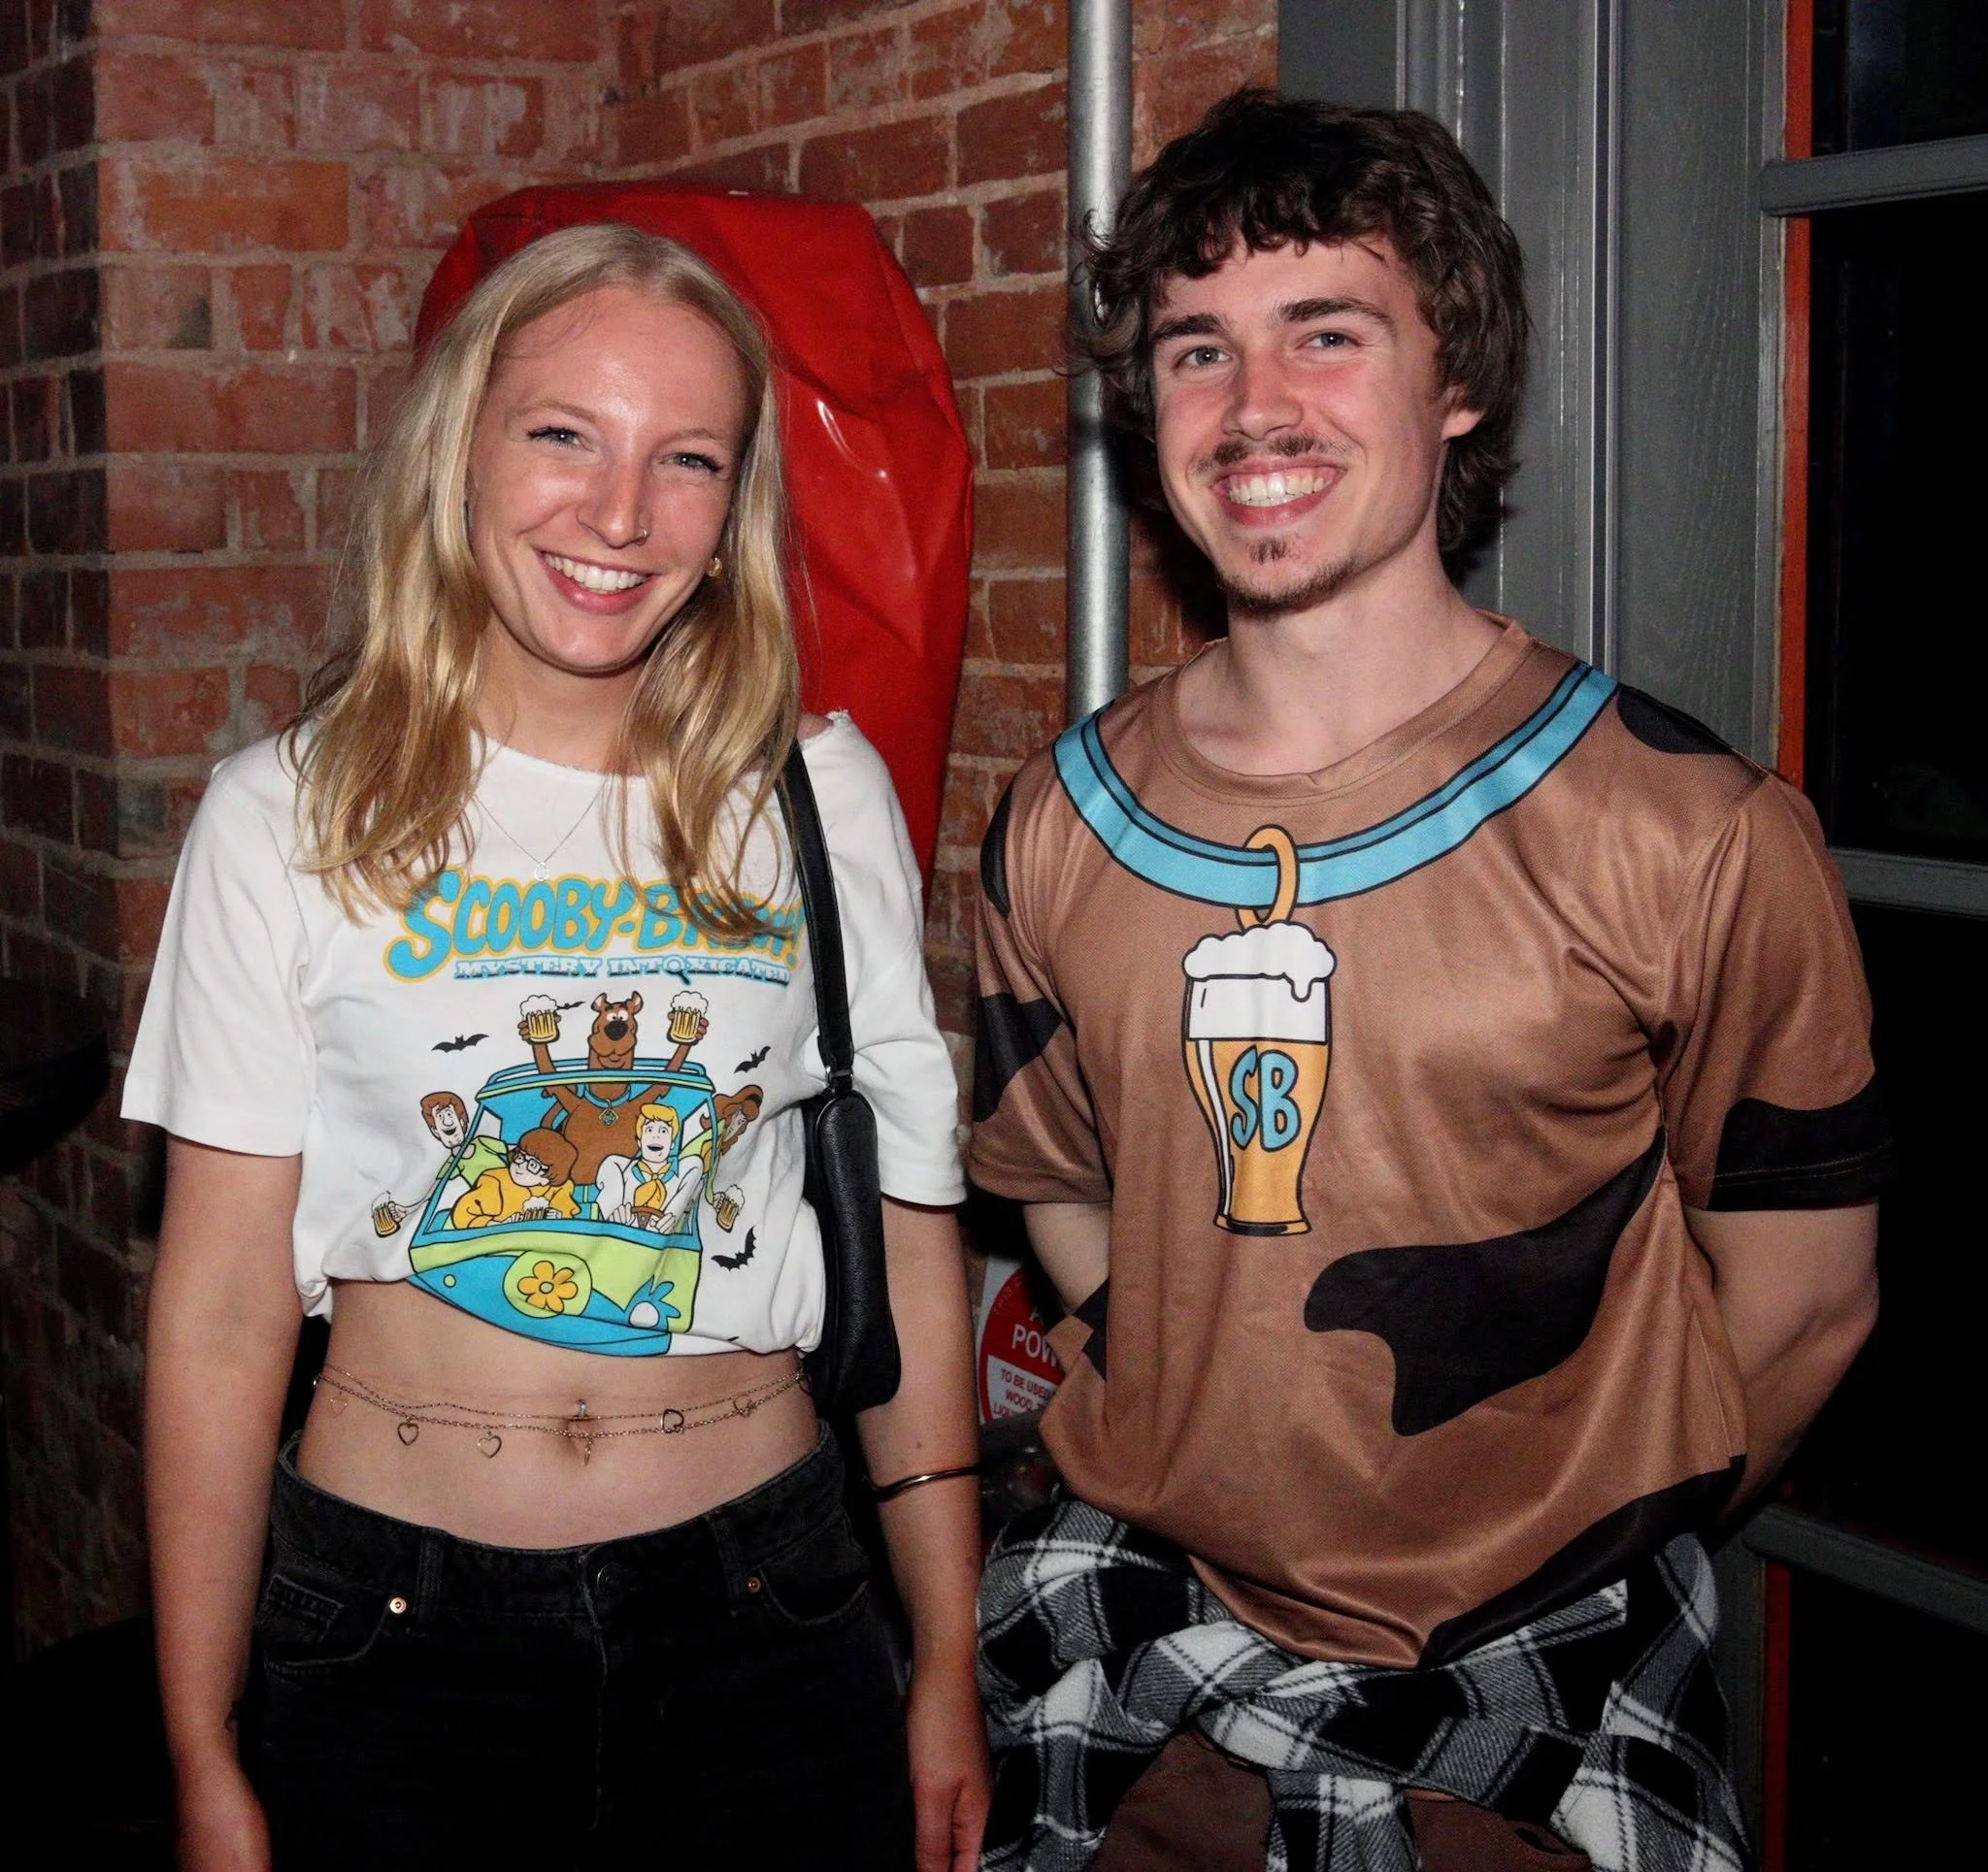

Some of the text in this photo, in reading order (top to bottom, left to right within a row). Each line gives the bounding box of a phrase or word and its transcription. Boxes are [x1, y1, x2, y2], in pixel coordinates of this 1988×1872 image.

[455, 955, 790, 987] MYSTERY INTOXICATED
[1229, 1045, 1301, 1153] SB
[1001, 1367, 1050, 1400] TO BE USED
